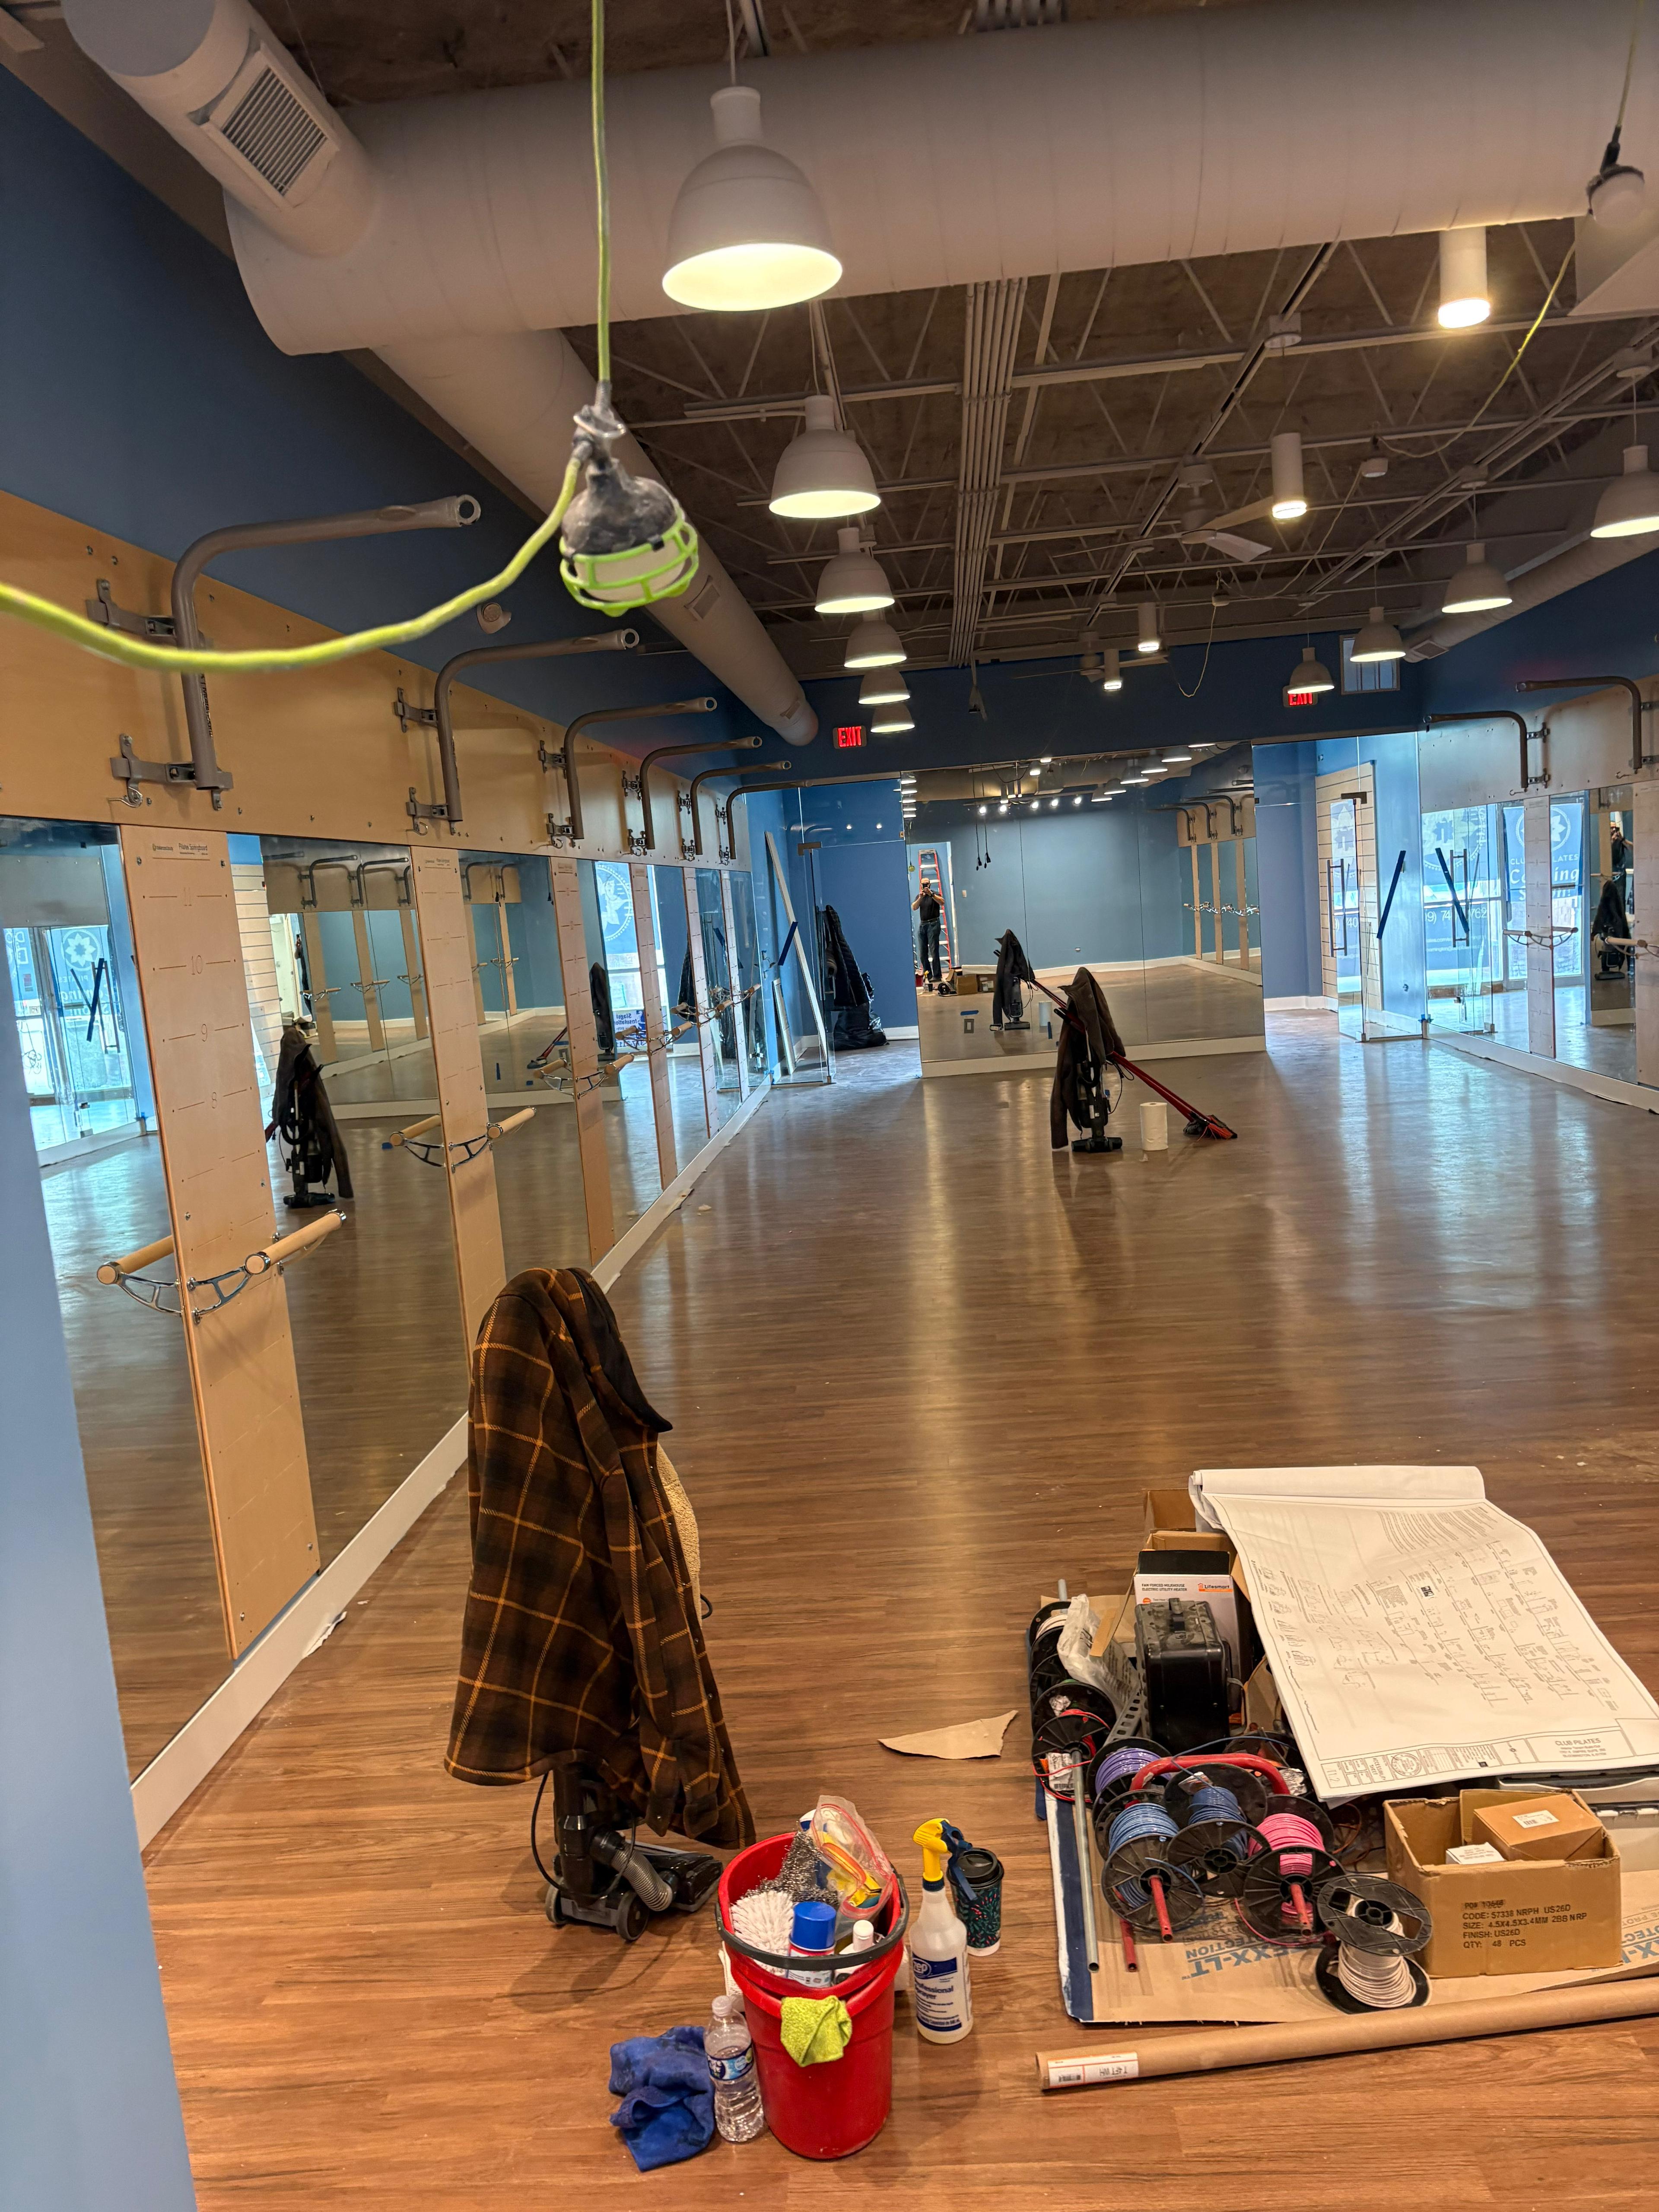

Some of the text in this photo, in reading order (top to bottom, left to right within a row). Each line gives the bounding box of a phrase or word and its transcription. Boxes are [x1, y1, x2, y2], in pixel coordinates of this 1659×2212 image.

[838, 726, 862, 747] EXIT
[1553, 854, 1579, 862] LATES
[191, 954, 203, 975] 10
[201, 1023, 208, 1042] 9
[211, 1091, 217, 1109] 8
[1516, 1907, 1539, 1916] NRPH
[1544, 1904, 1571, 1914] US26D
[1494, 1929, 1520, 1938] US26D
